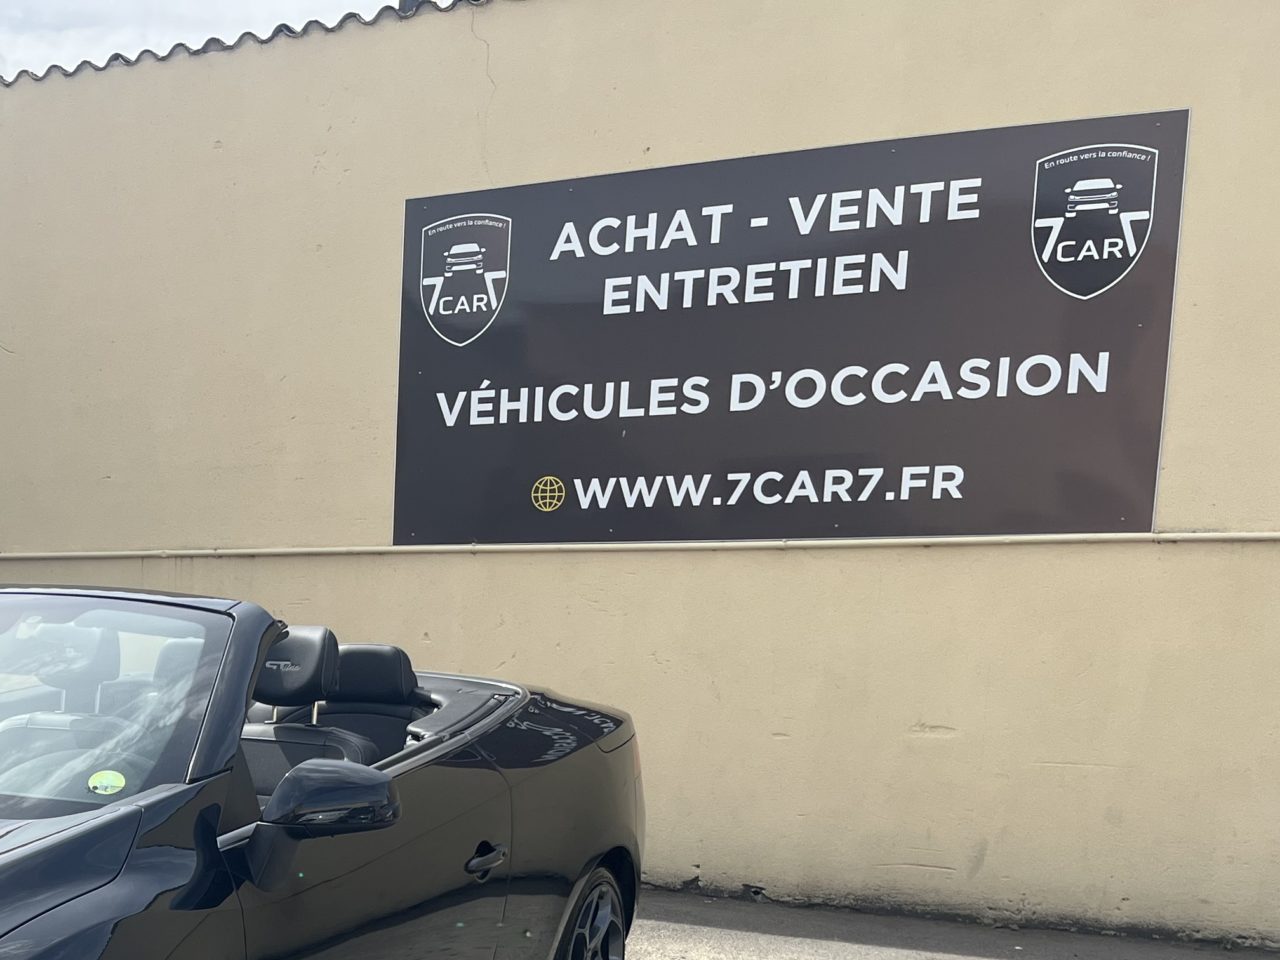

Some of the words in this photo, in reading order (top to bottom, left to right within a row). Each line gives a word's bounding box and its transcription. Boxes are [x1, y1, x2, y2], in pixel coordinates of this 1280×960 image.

[1056, 155, 1079, 166] route
[1080, 151, 1097, 160] vers
[1107, 151, 1146, 161] confiance
[428, 228, 436, 236] En
[437, 224, 453, 233] route
[453, 220, 467, 228] vers
[474, 219, 503, 228] confiance
[550, 204, 733, 260] ACHAT
[751, 217, 768, 227] -
[789, 178, 981, 236] VENTE
[604, 251, 908, 315] ENTRETIEN
[437, 377, 709, 427] VÉHICULES
[730, 352, 1109, 411] D'OCCASION
[574, 466, 964, 509] WWW.7CAR7.FR
